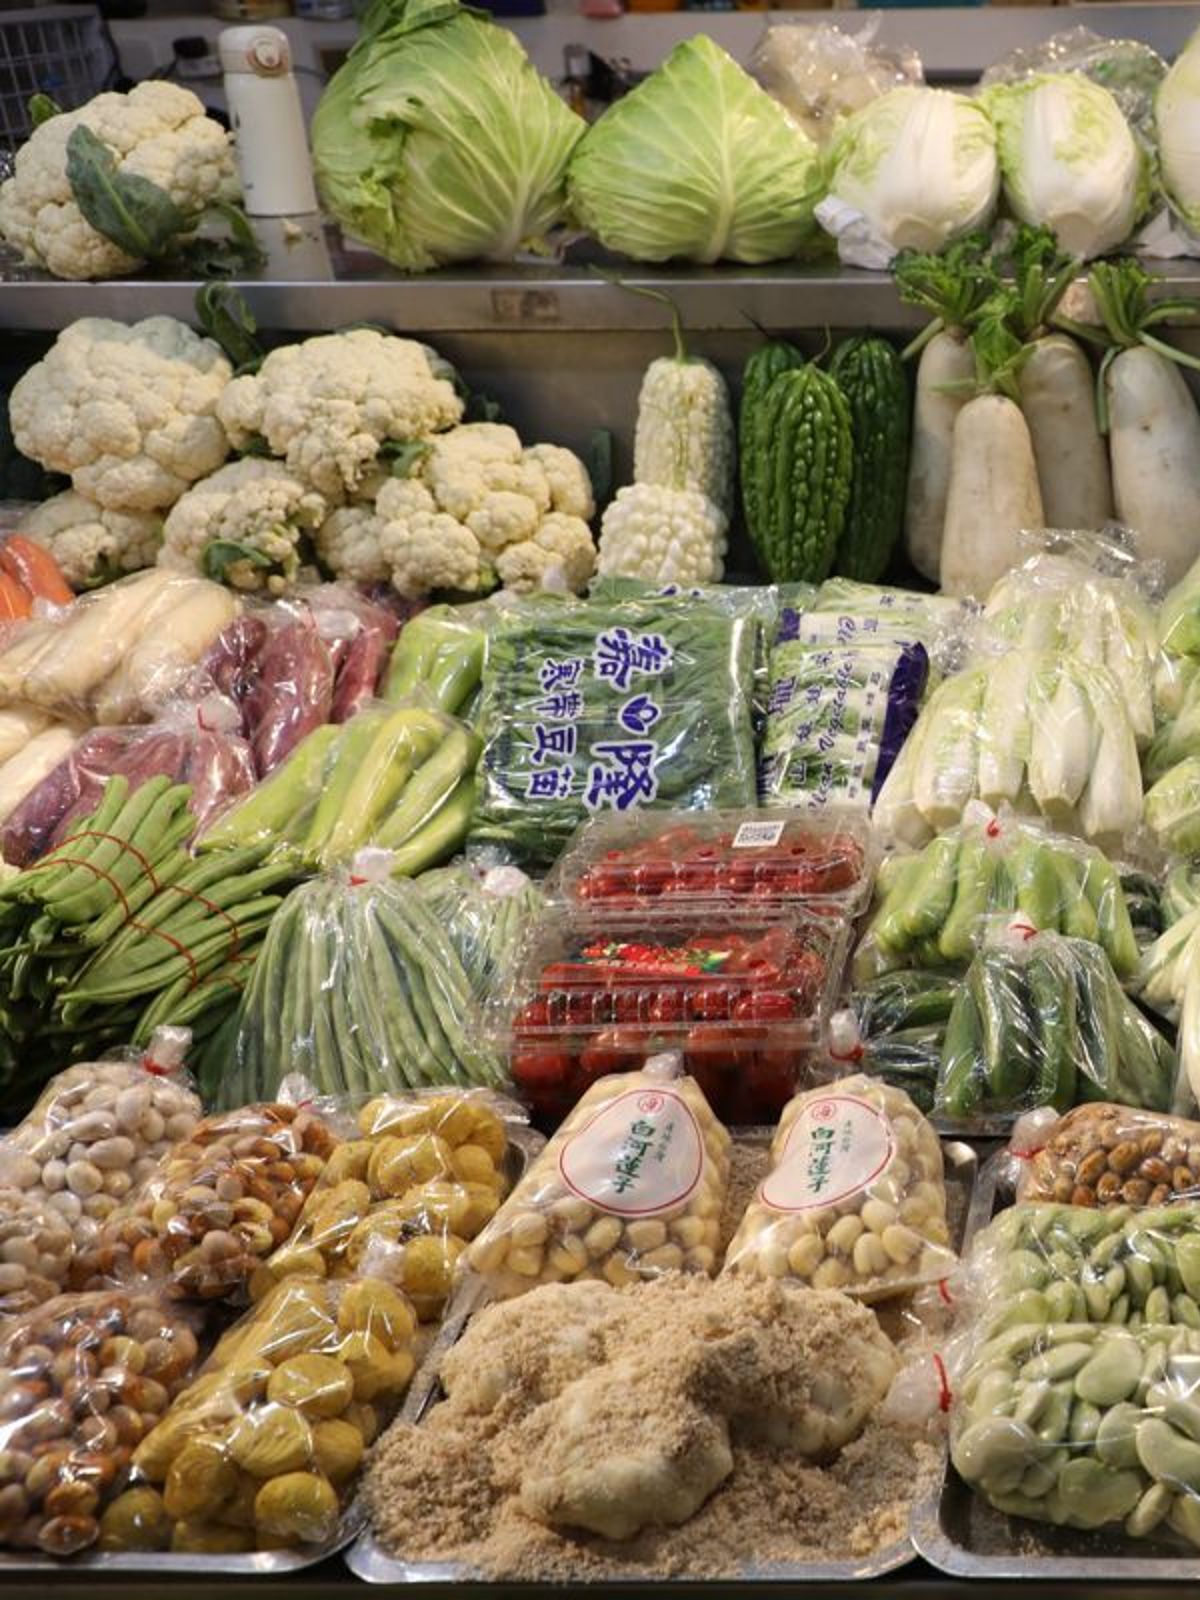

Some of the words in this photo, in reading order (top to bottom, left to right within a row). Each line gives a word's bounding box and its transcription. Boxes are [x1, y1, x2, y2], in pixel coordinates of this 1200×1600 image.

[527, 658, 585, 799] 寒帶豆苗
[587, 627, 671, 810] 嘉隆
